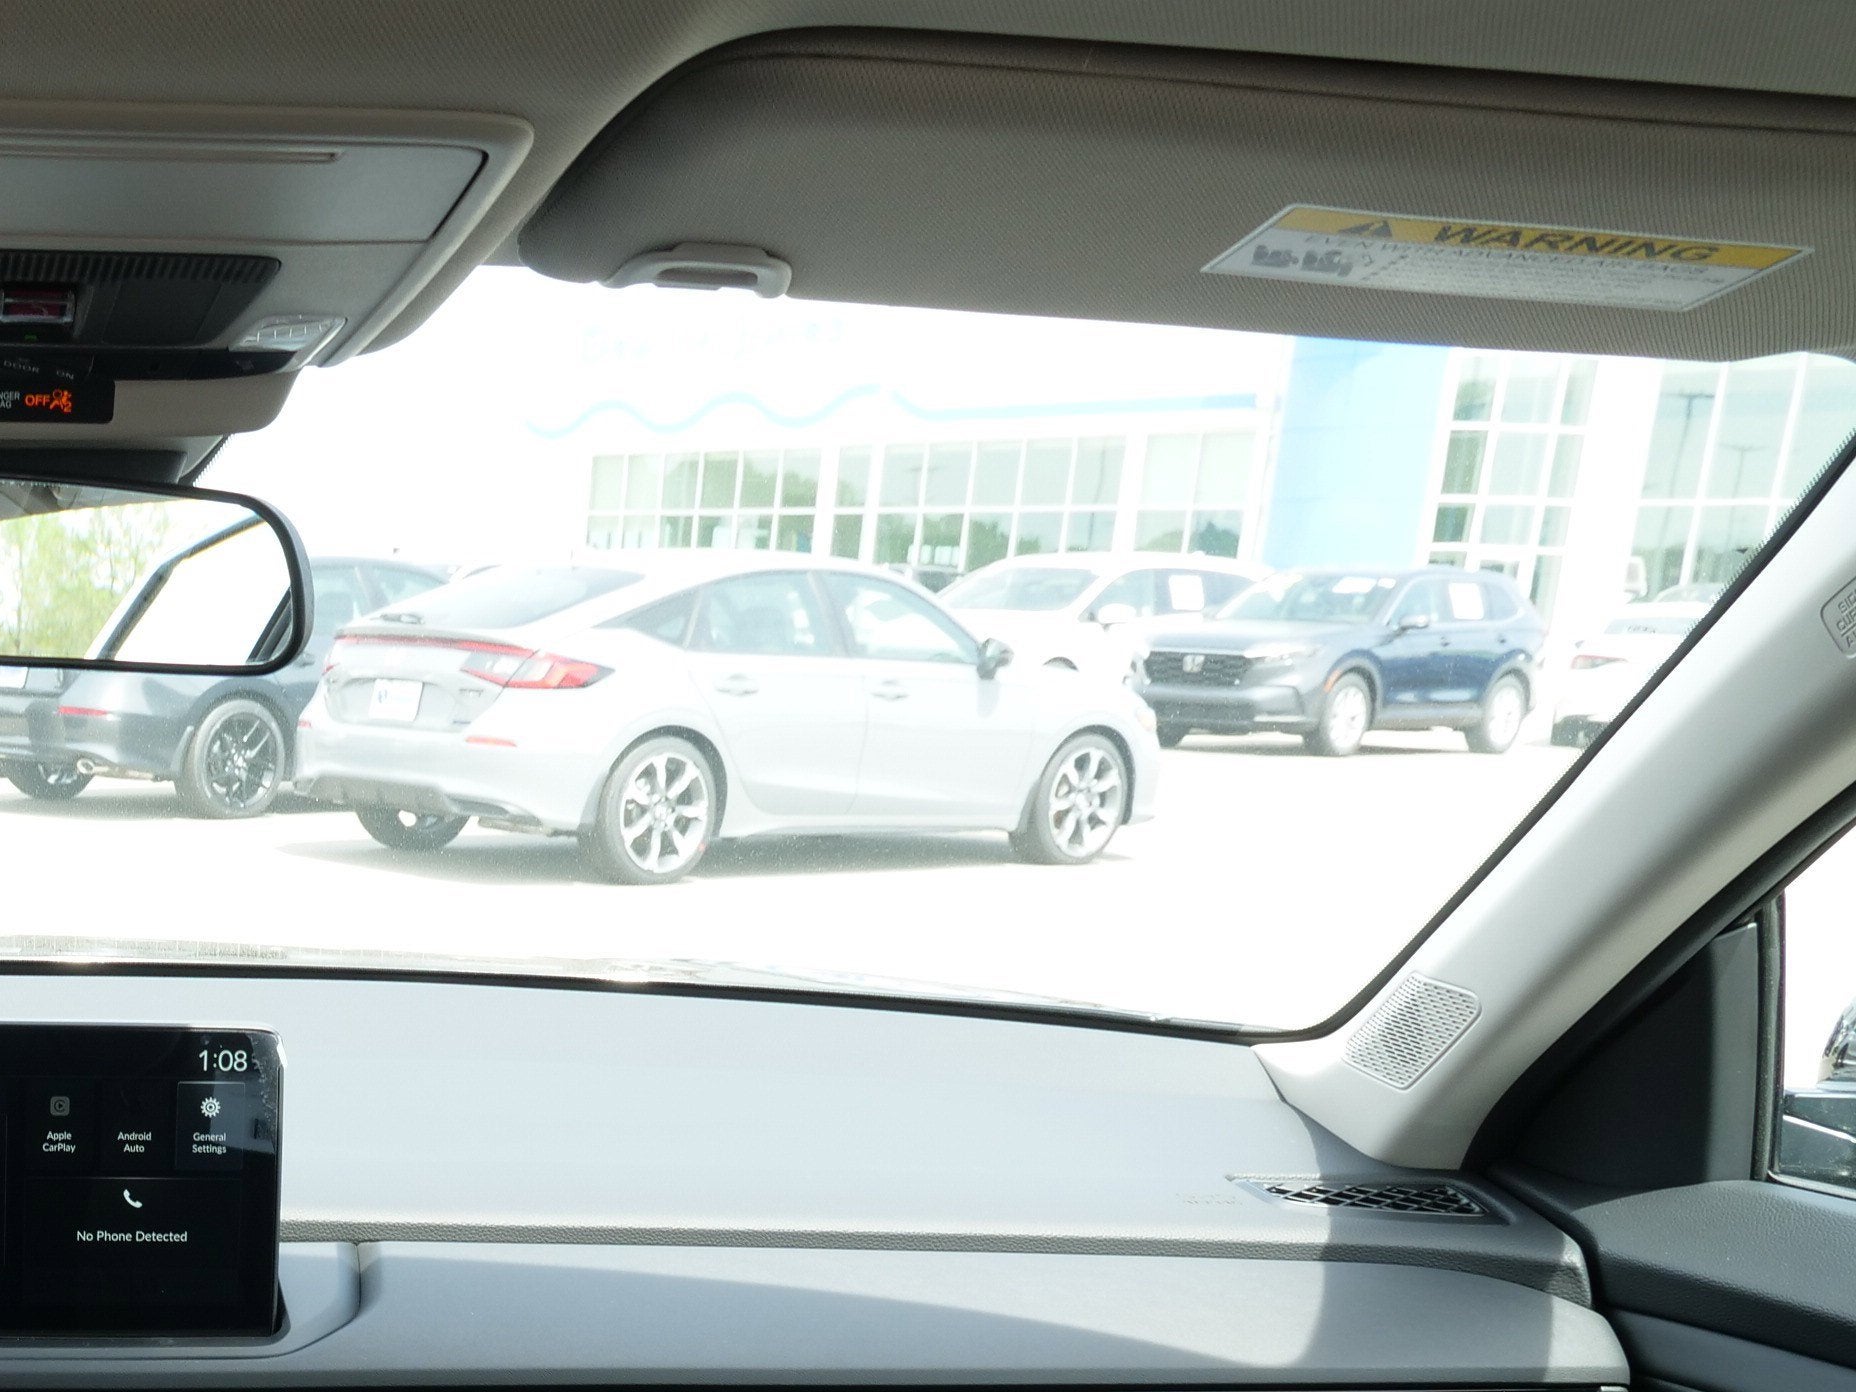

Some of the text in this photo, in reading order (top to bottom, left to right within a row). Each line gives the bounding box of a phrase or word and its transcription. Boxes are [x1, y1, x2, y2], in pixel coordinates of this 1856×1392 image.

[1435, 225, 1720, 262] WARNING
[4, 360, 40, 374] DOOR
[24, 394, 51, 407] OFF
[198, 1050, 248, 1072] 1:08
[46, 1131, 72, 1143] Apple
[117, 1131, 152, 1142] Android
[193, 1132, 226, 1142] General
[42, 1143, 76, 1155] CarPlay
[123, 1143, 145, 1154] Auto
[192, 1143, 226, 1155] Settings
[76, 1230, 188, 1242] No Phone Detected
